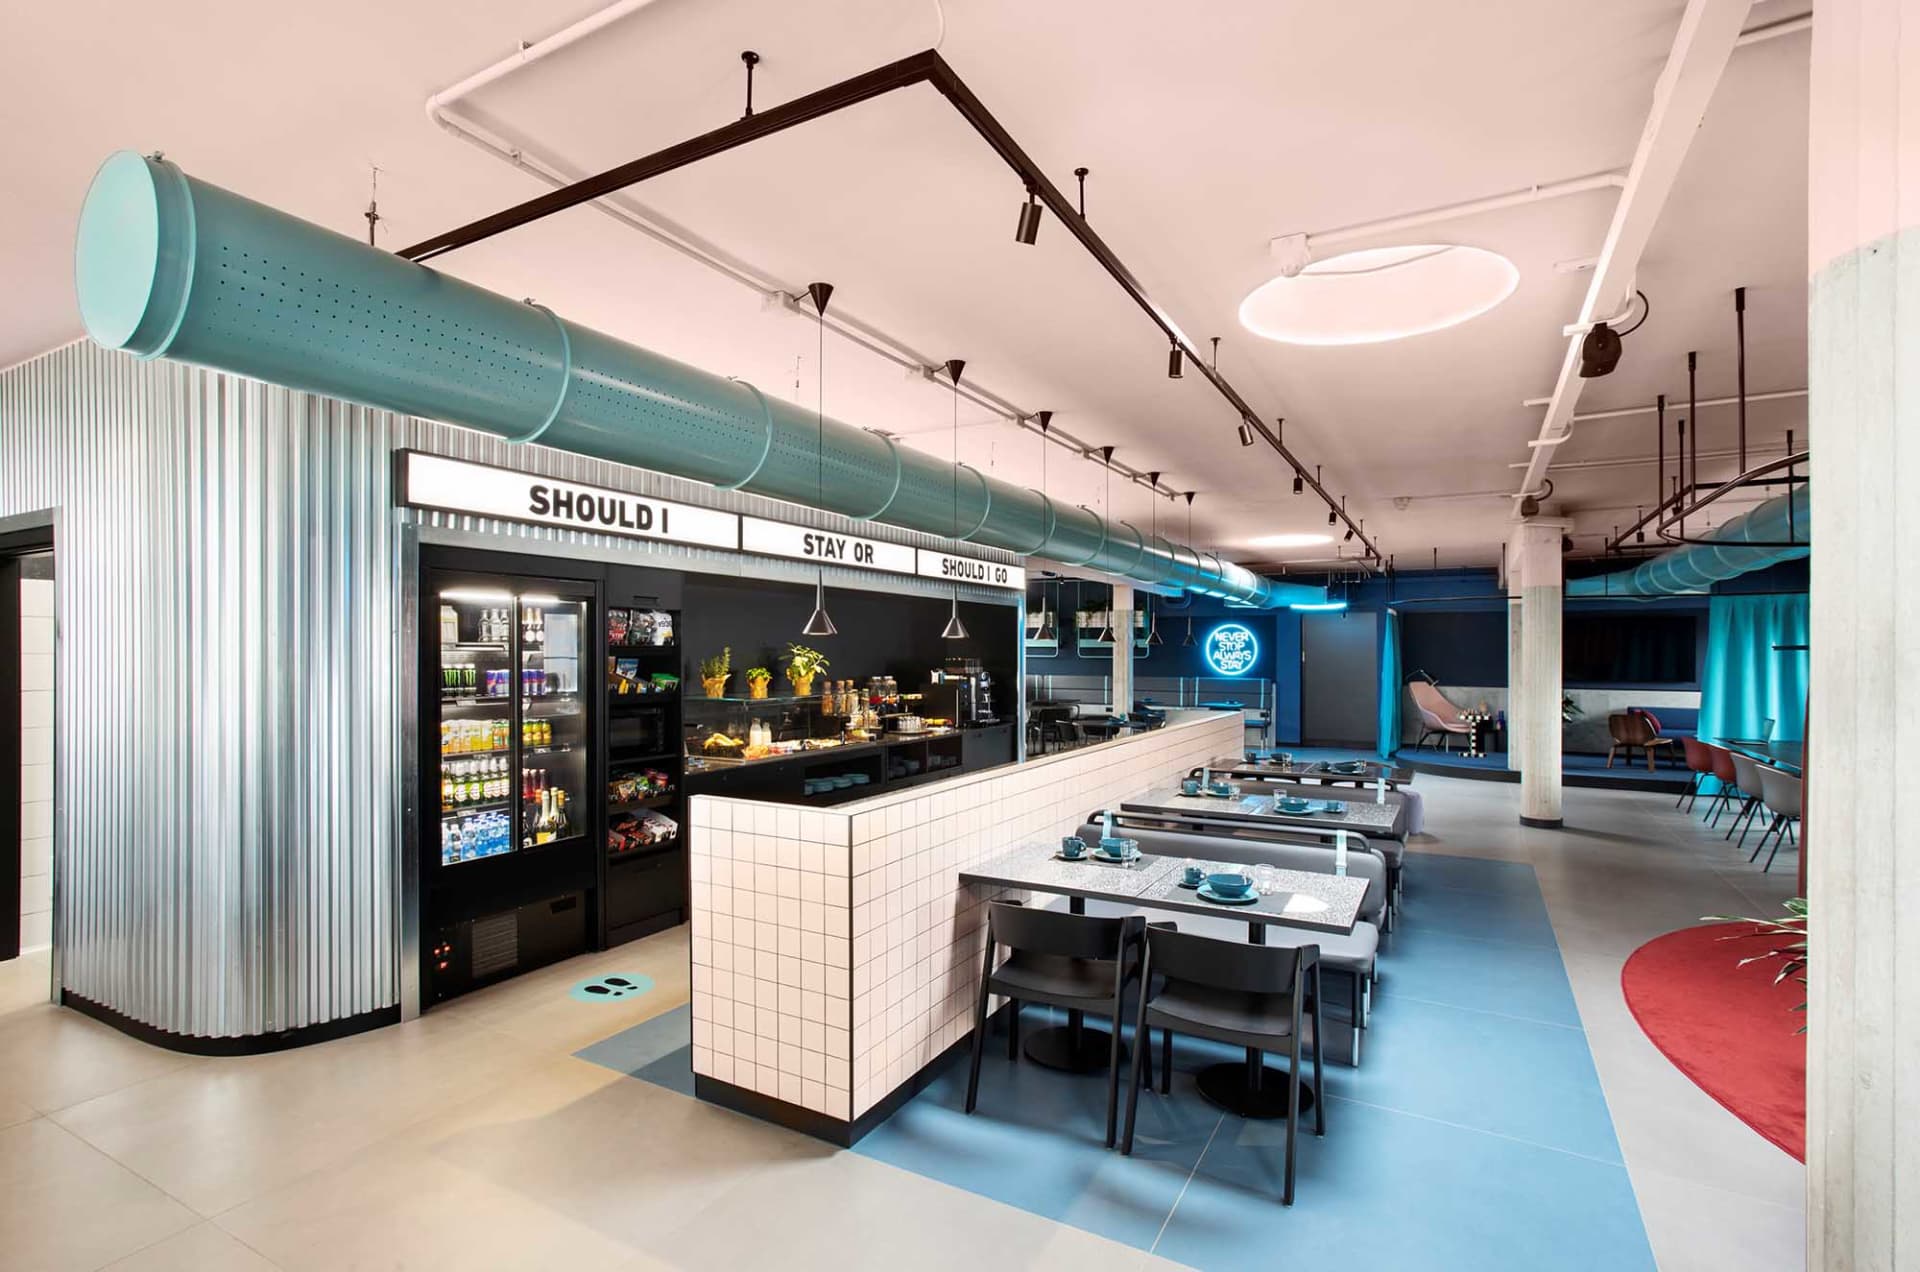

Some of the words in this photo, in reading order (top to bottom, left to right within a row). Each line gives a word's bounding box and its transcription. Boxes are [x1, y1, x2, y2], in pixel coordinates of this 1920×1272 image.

[529, 485, 653, 531] SHOULD
[662, 508, 669, 534] I
[803, 533, 846, 559] STAY
[854, 542, 874, 564] OR
[942, 558, 984, 581] SHOULD
[987, 565, 990, 581] I
[995, 567, 1008, 584] GO
[1215, 632, 1249, 641] NEVER
[1219, 641, 1245, 651] STOP
[1213, 650, 1252, 661] ALWAYS
[1220, 660, 1244, 670] STAY
